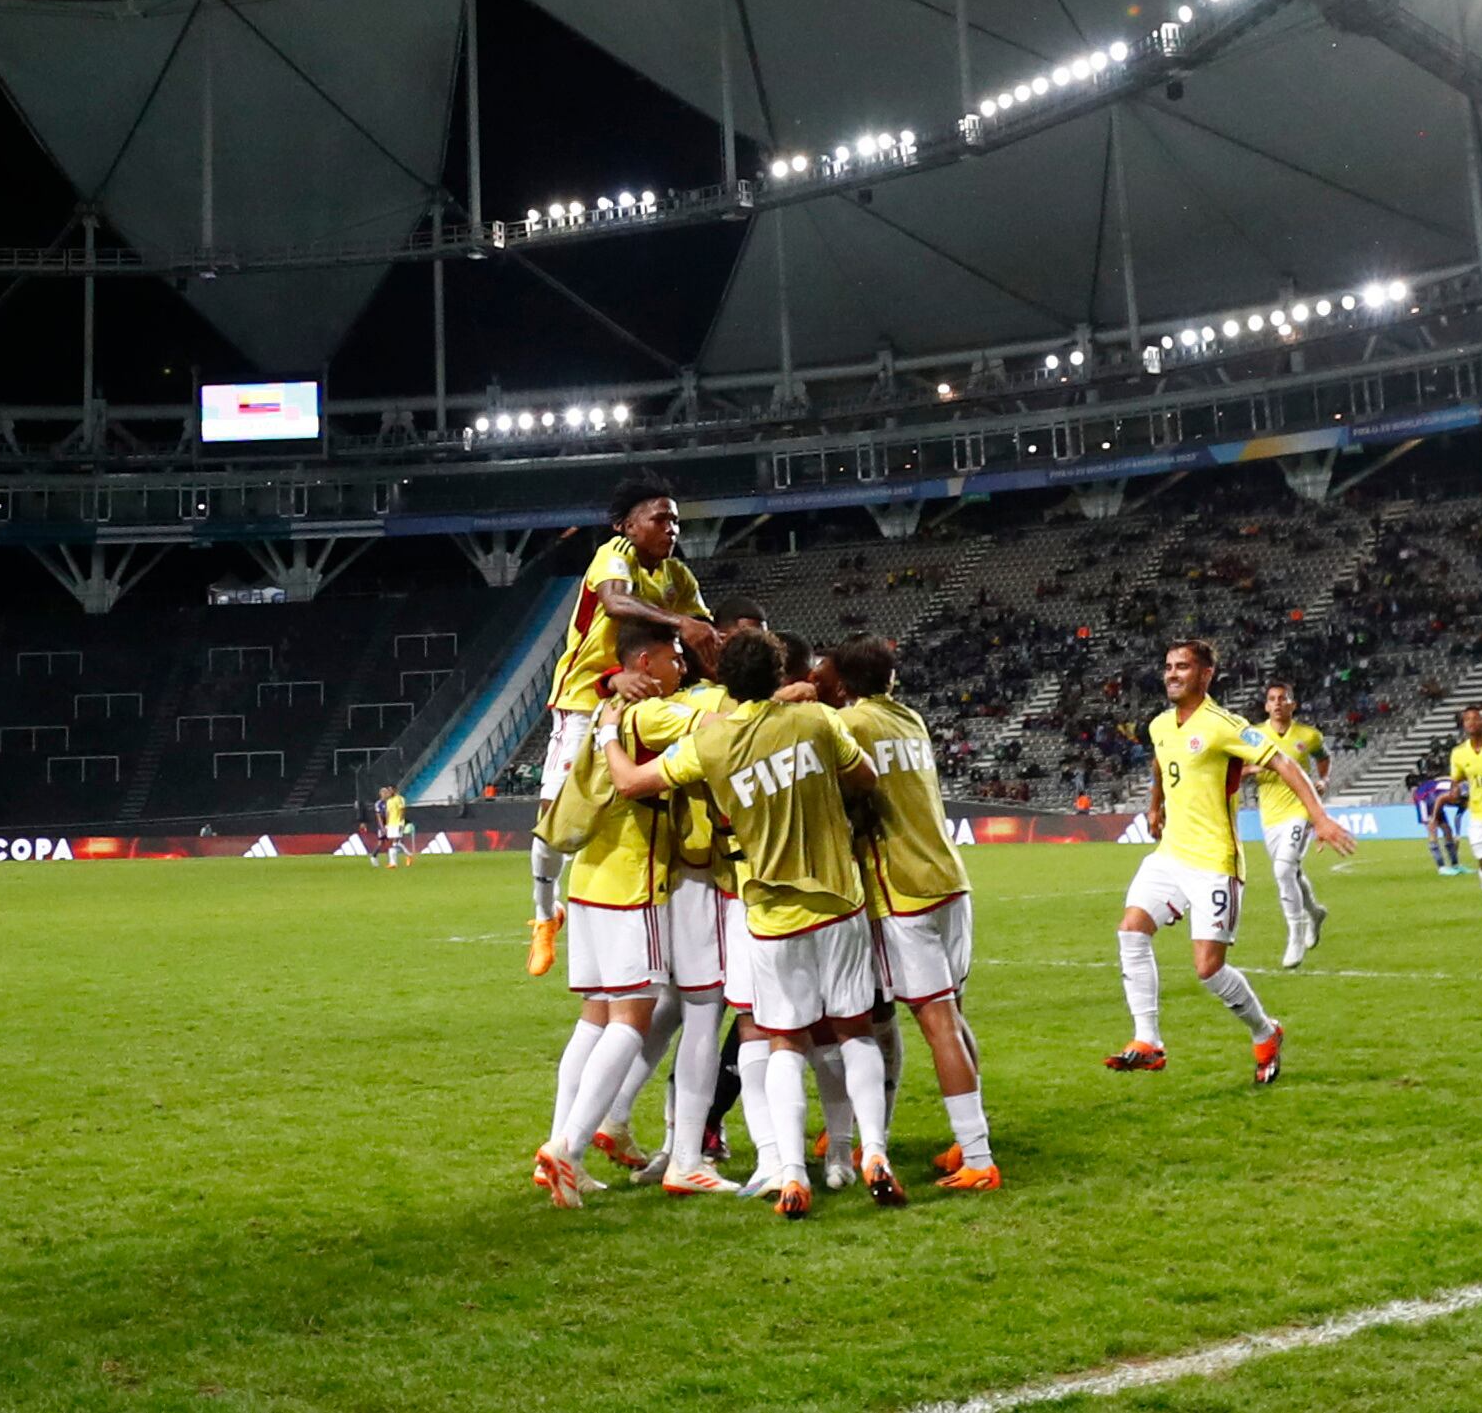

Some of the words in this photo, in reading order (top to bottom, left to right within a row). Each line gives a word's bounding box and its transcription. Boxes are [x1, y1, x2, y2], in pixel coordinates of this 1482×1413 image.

[874, 738, 937, 775] FIFA
[729, 740, 824, 809] FIFA
[1168, 761, 1181, 788] 9
[944, 817, 976, 845] PA
[1291, 825, 1302, 842] 8
[1337, 813, 1378, 834] ATA
[1211, 889, 1228, 917] 9
